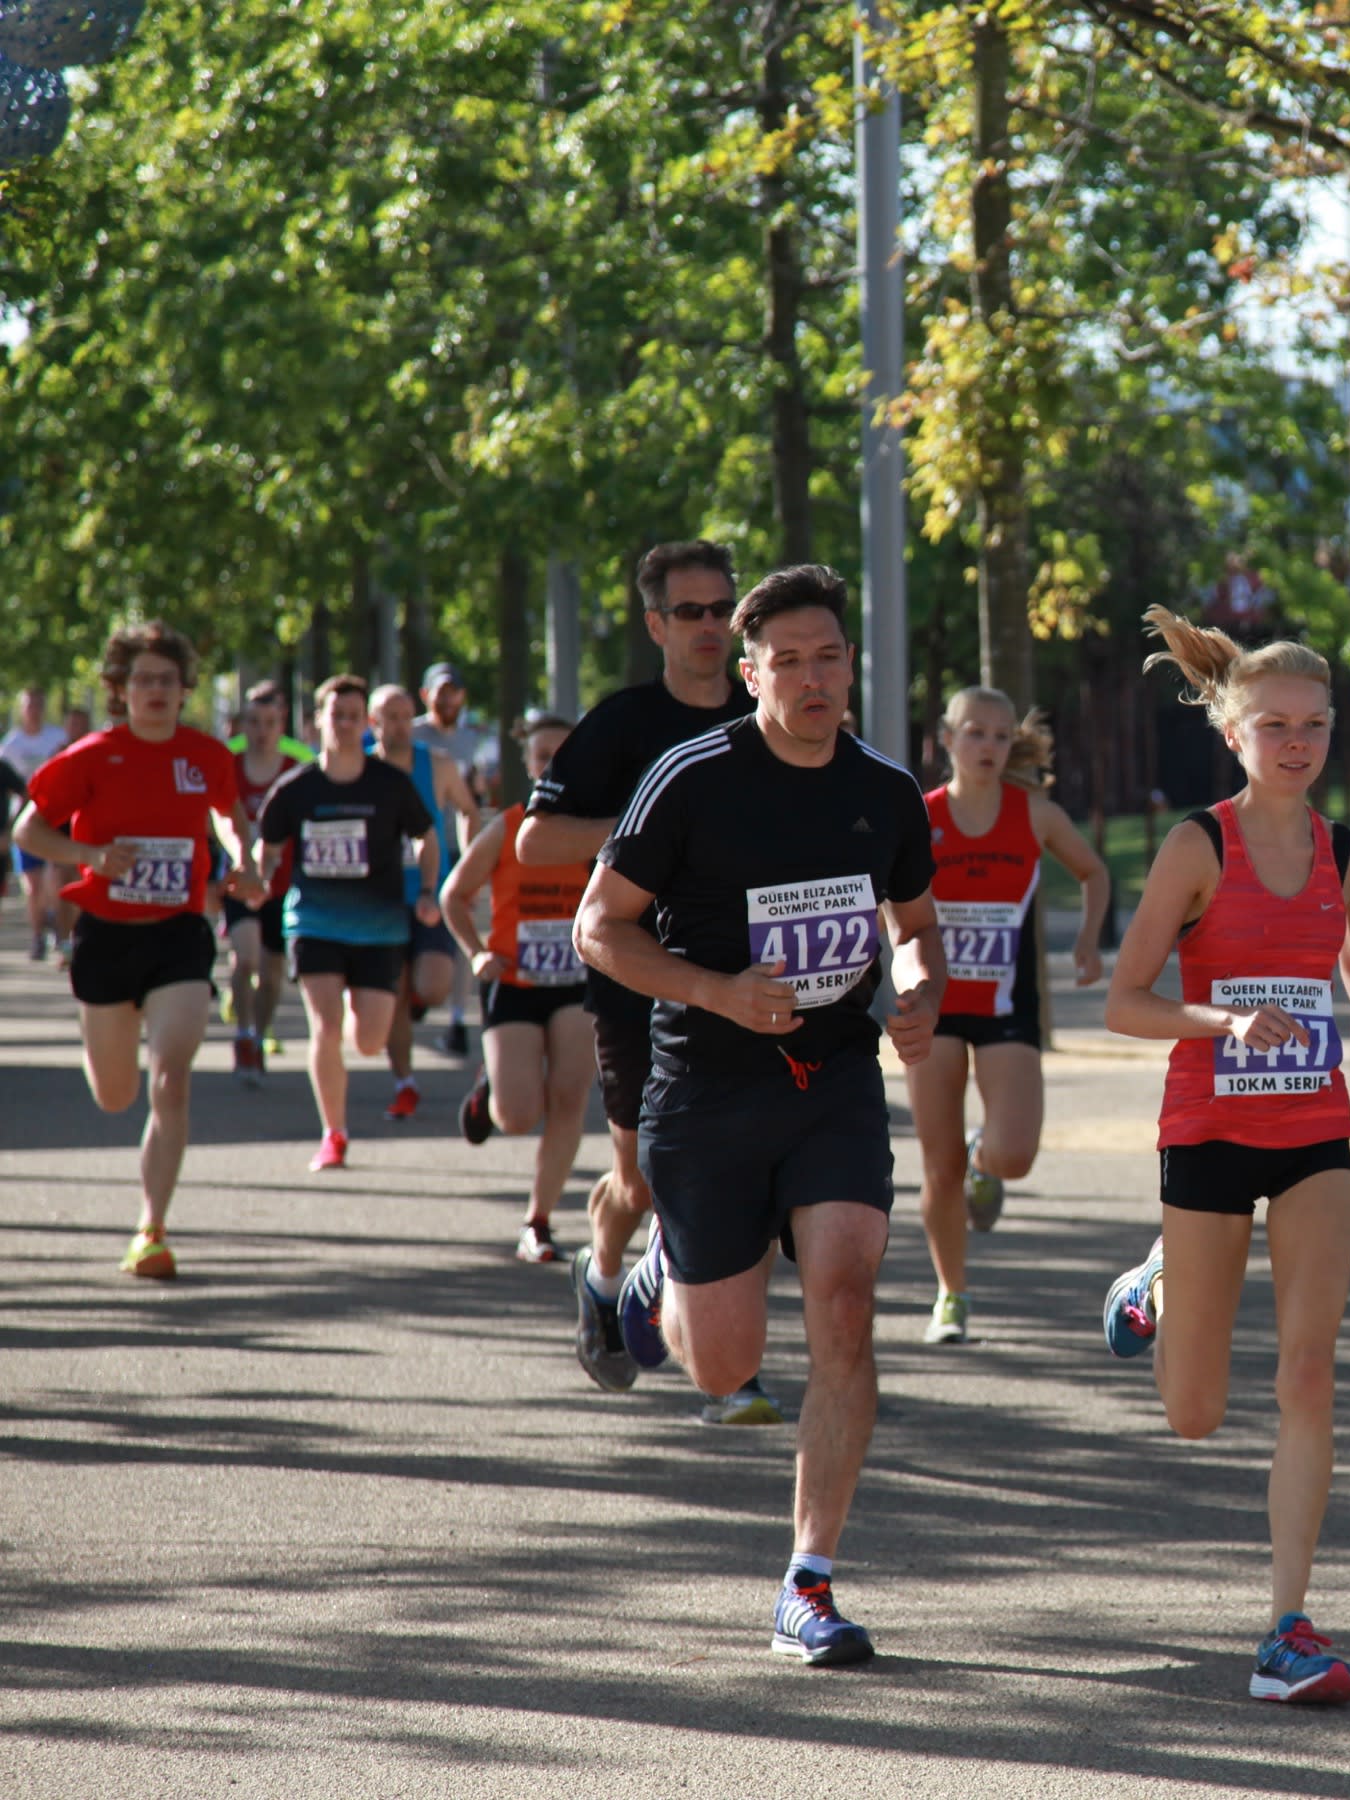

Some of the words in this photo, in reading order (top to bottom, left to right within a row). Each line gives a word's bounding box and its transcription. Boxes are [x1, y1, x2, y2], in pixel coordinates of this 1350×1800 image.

[757, 889, 800, 906] QUEEN
[803, 881, 864, 899] ELIZABETH
[768, 900, 821, 917] OLYMPIC
[824, 895, 857, 910] PARK
[760, 915, 870, 970] 4122
[942, 928, 1011, 963] 4271
[816, 968, 862, 990] SERI
[1221, 984, 1266, 996] QUEEN
[1271, 984, 1323, 998] ELIZABETH
[1292, 998, 1317, 1010] PARK
[1228, 1077, 1277, 1092] 10KM
[1284, 1076, 1326, 1090] SERIE
